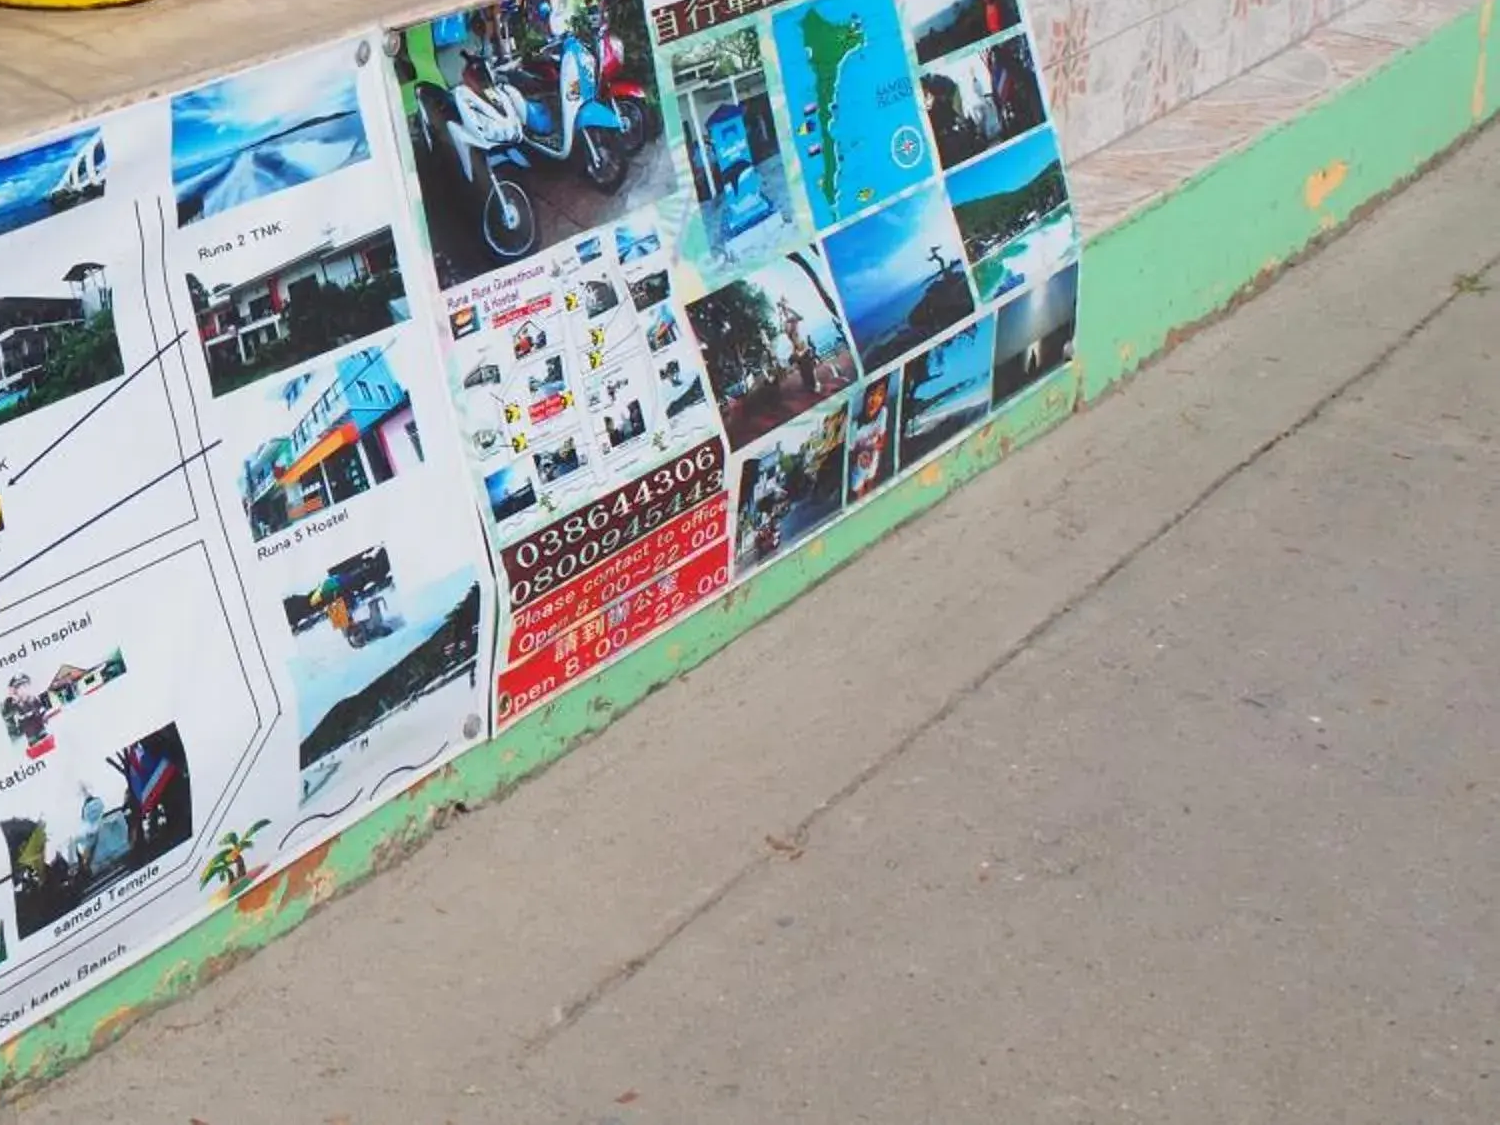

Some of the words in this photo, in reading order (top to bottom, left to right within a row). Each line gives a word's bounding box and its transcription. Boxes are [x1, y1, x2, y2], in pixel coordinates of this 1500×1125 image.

[198, 242, 233, 261] Runa
[237, 235, 246, 248] 2
[250, 221, 284, 241] TNK
[515, 446, 715, 568] 038644306
[257, 538, 291, 561] Runa
[306, 509, 350, 536] Hostel
[511, 469, 724, 605] 0800945443
[514, 589, 576, 629] Please
[583, 544, 651, 594] contact
[657, 529, 675, 548] to
[681, 500, 727, 534] office
[31, 612, 93, 652] hospital
[518, 614, 570, 654] Open
[498, 675, 556, 719] Open
[52, 899, 103, 937] samed
[107, 865, 160, 902] Temple
[31, 979, 72, 1011] kaew
